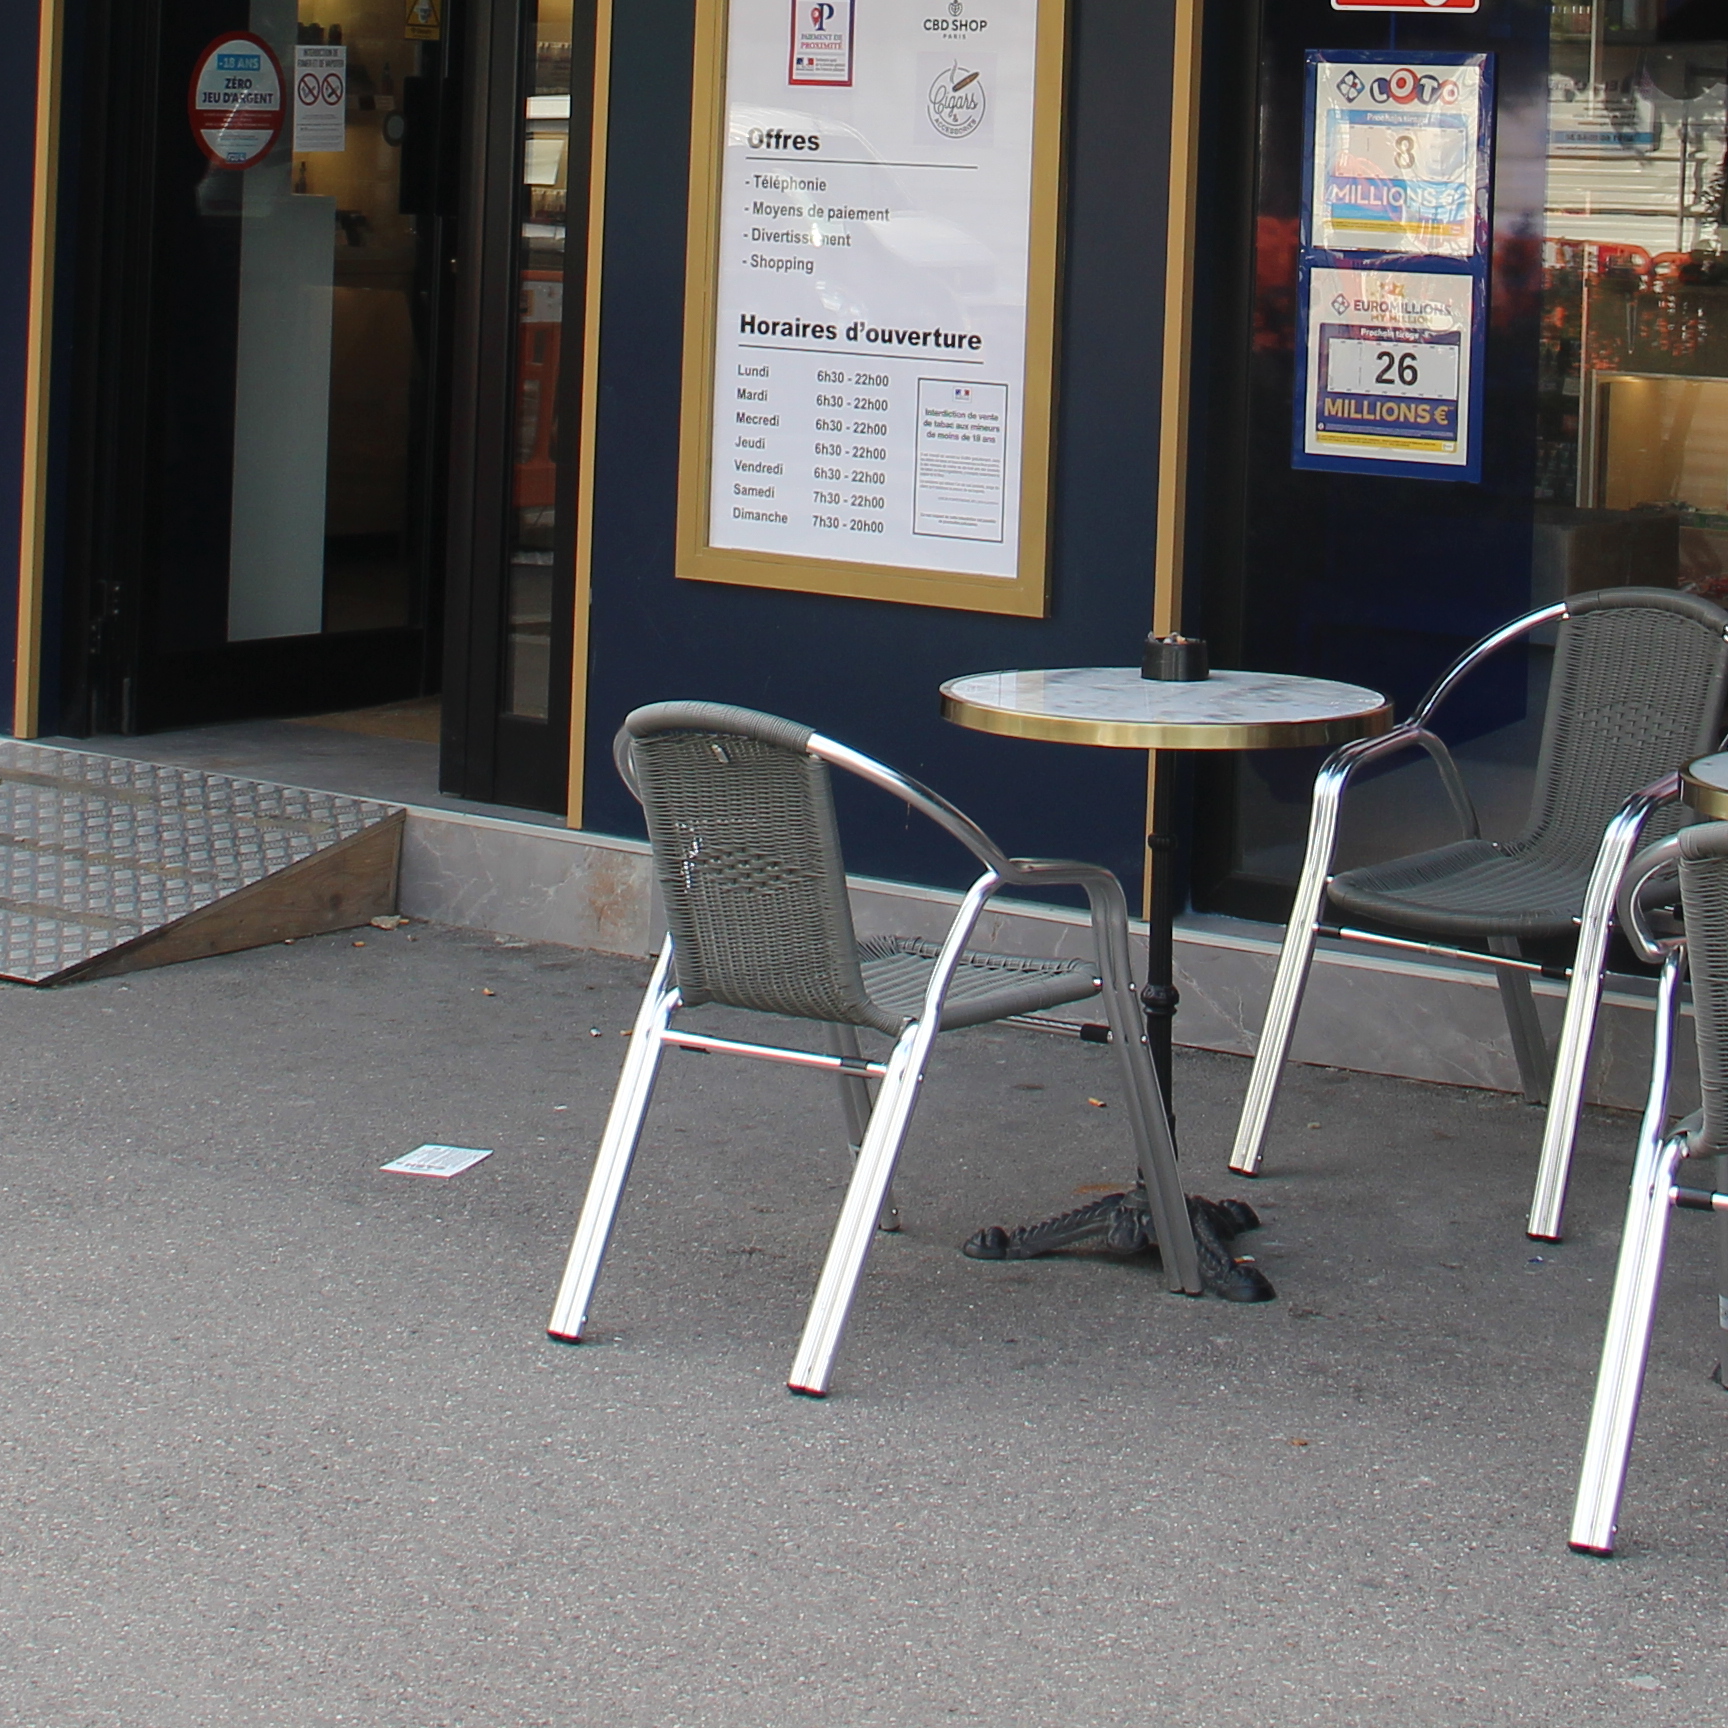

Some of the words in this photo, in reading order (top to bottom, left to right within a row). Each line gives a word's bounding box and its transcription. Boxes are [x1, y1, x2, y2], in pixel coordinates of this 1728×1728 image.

[923, 18, 949, 32] CBD
[951, 18, 988, 33] SHOP
[236, 58, 259, 69] ANS
[225, 76, 253, 89] ZÉRO
[1370, 68, 1460, 105] LOTO
[202, 92, 221, 104] JEU
[223, 92, 274, 104] D'ARGENT
[933, 85, 978, 118] Cigars
[747, 127, 821, 152] Offres
[1394, 135, 1415, 170] 8
[753, 174, 827, 193] Téléphonie
[1331, 183, 1438, 208] MILLIONS
[752, 201, 803, 219] Moyens
[807, 203, 824, 218] de
[827, 206, 890, 222] paiement
[750, 254, 814, 274] Shopping
[1353, 299, 1452, 317] EUROMILLIONS
[740, 313, 838, 341] Horaires
[845, 321, 982, 351] d'ouverture
[1360, 328, 1395, 339] Prochain
[738, 364, 769, 377] Lundi
[817, 370, 845, 383] 6h30
[855, 373, 889, 387] 22h00
[1375, 351, 1419, 387] 26
[737, 388, 768, 402] Mardi
[816, 395, 844, 408] 6h30
[854, 398, 888, 411] 22h00
[1324, 397, 1431, 424] MILLIONS
[1434, 404, 1449, 425] €
[736, 412, 780, 427] Mecredi
[815, 419, 842, 432] 6h30
[853, 422, 887, 436] 22h00
[923, 419, 932, 428] de
[934, 419, 954, 430] tabac
[970, 423, 1000, 433] mineurs
[925, 408, 966, 420] Interdiction
[967, 412, 977, 421] de
[735, 436, 765, 449] Jeudi
[815, 443, 842, 456] 6h30
[852, 446, 886, 460] 22h00
[926, 431, 936, 439] de
[937, 431, 960, 441] moins
[961, 433, 971, 442] de
[734, 460, 783, 475] Vendredi
[814, 467, 841, 480] 6h30
[851, 470, 885, 485] 22h00
[734, 484, 775, 498] Samedi
[813, 491, 840, 505] 7h30
[851, 495, 885, 509] 22h00
[733, 508, 788, 523] Dimanche
[812, 515, 839, 529] 7h30
[850, 519, 884, 533] 20h00
